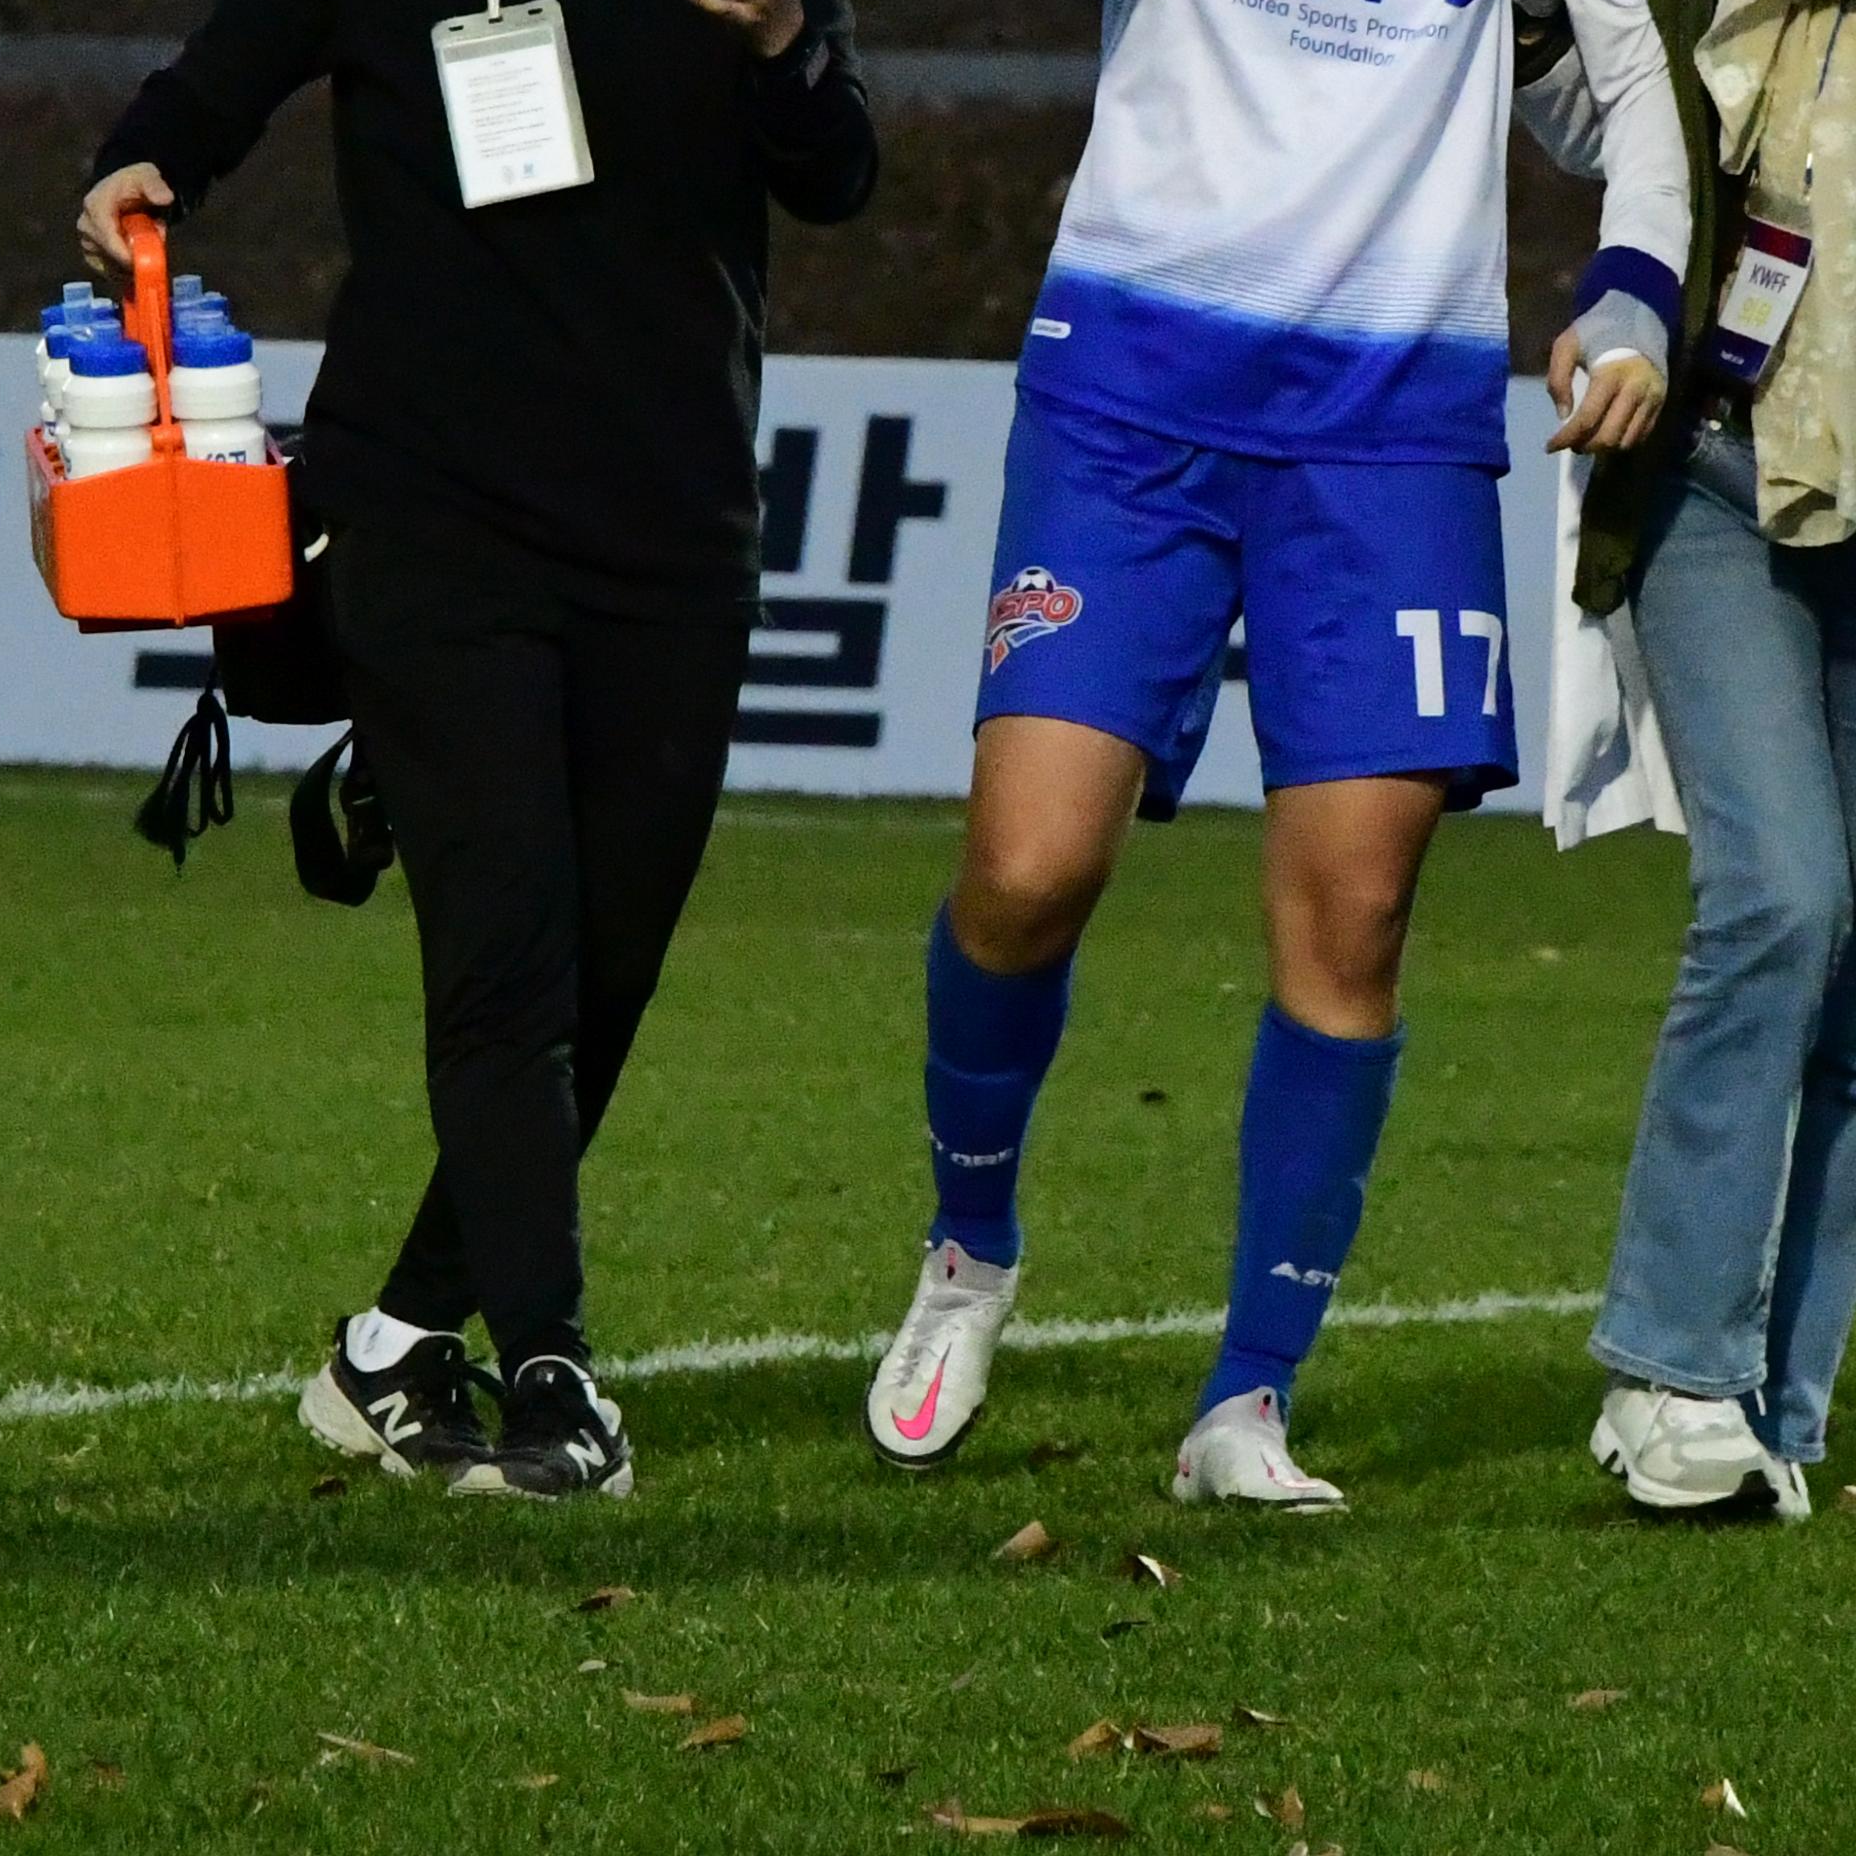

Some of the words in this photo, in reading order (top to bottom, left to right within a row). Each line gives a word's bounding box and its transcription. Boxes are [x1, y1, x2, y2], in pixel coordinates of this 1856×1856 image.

[1297, 2, 1358, 33] Sports
[1748, 263, 1791, 294] KWFF
[1396, 609, 1503, 717] 17
